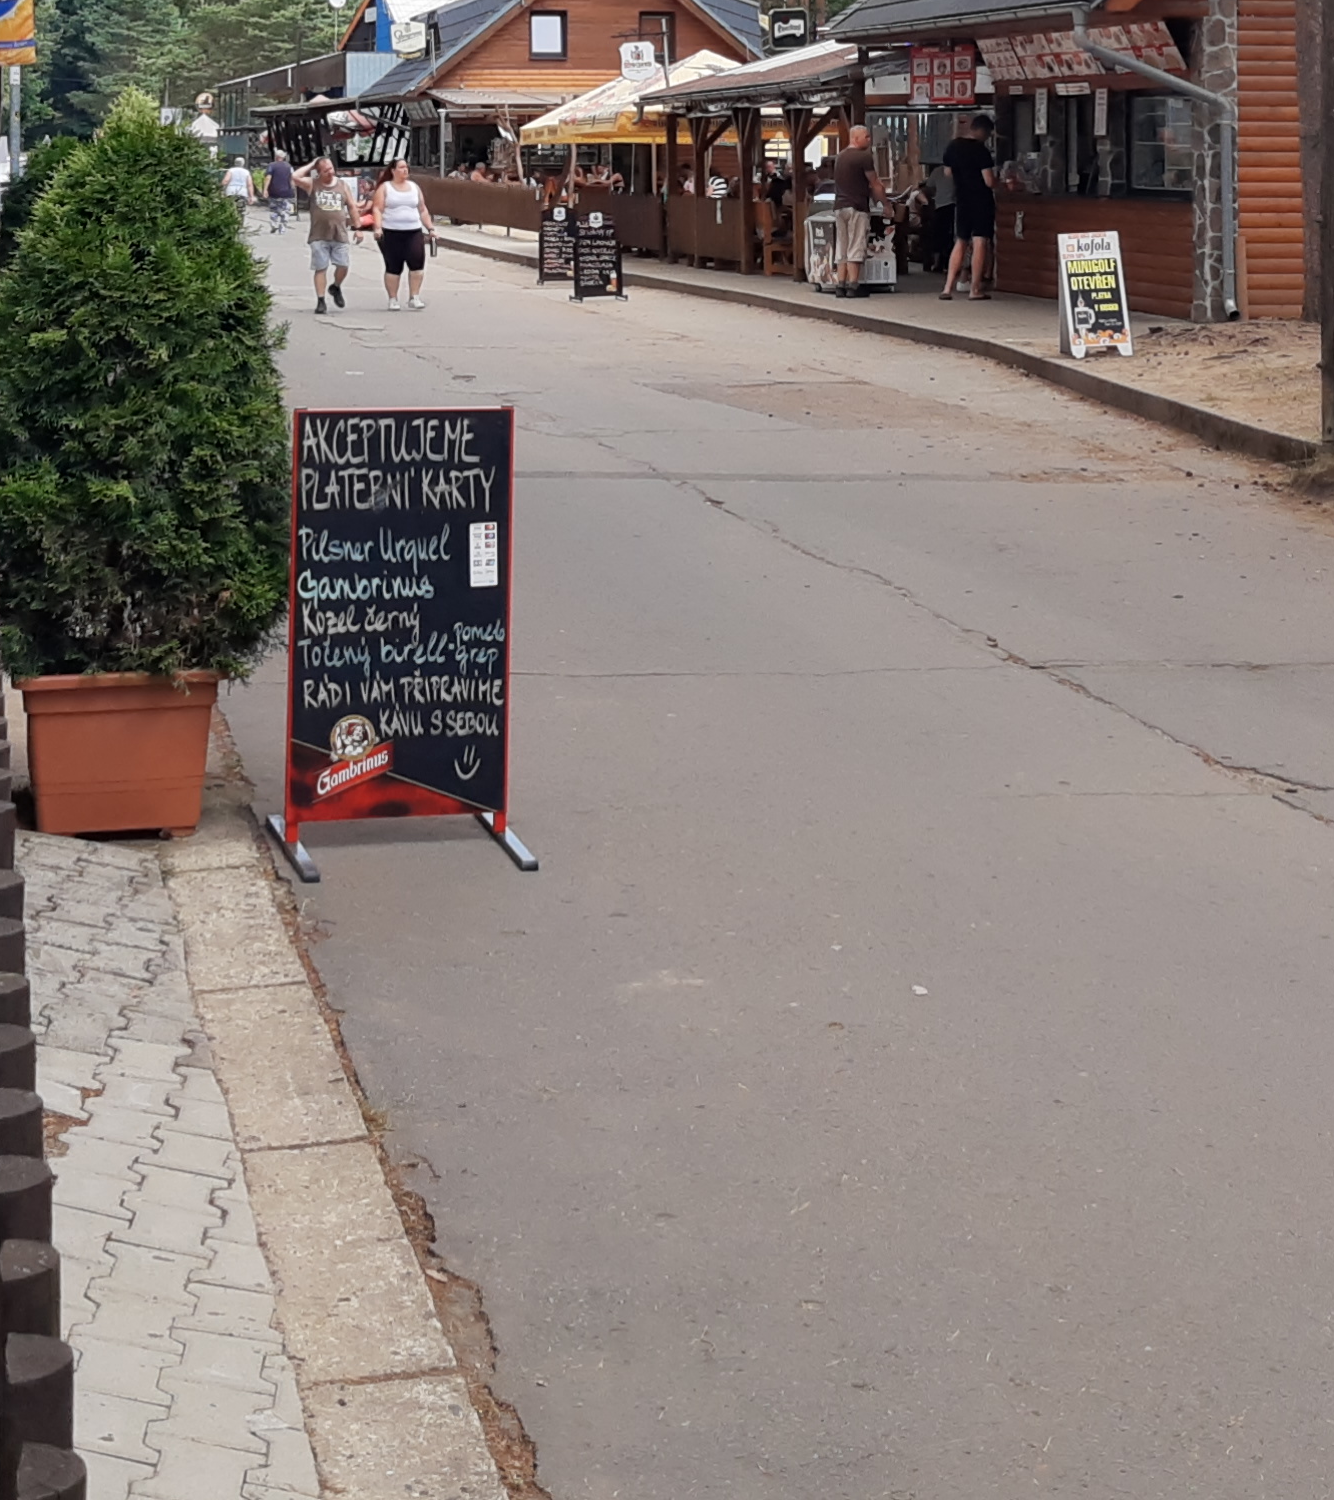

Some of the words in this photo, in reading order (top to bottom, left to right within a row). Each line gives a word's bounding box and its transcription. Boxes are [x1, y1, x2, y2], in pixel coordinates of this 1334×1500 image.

[1068, 258, 1116, 274] MINIGOLF
[1077, 238, 1111, 256] kofola
[1070, 273, 1116, 291] OTEVŘEN
[302, 416, 480, 464] AKCEPTUJEME
[301, 466, 415, 511] PLATEBNÍ
[422, 466, 496, 513] KARTY
[298, 525, 374, 563] Pilsner
[297, 568, 434, 608] Gambrinus
[302, 602, 361, 636] Kozel
[303, 673, 351, 708] RÁDI
[360, 671, 396, 704] VÁM
[399, 668, 505, 706] PŘIPRAVÍME
[379, 703, 424, 738] KÁVU
[317, 750, 389, 795] Gambrinus
